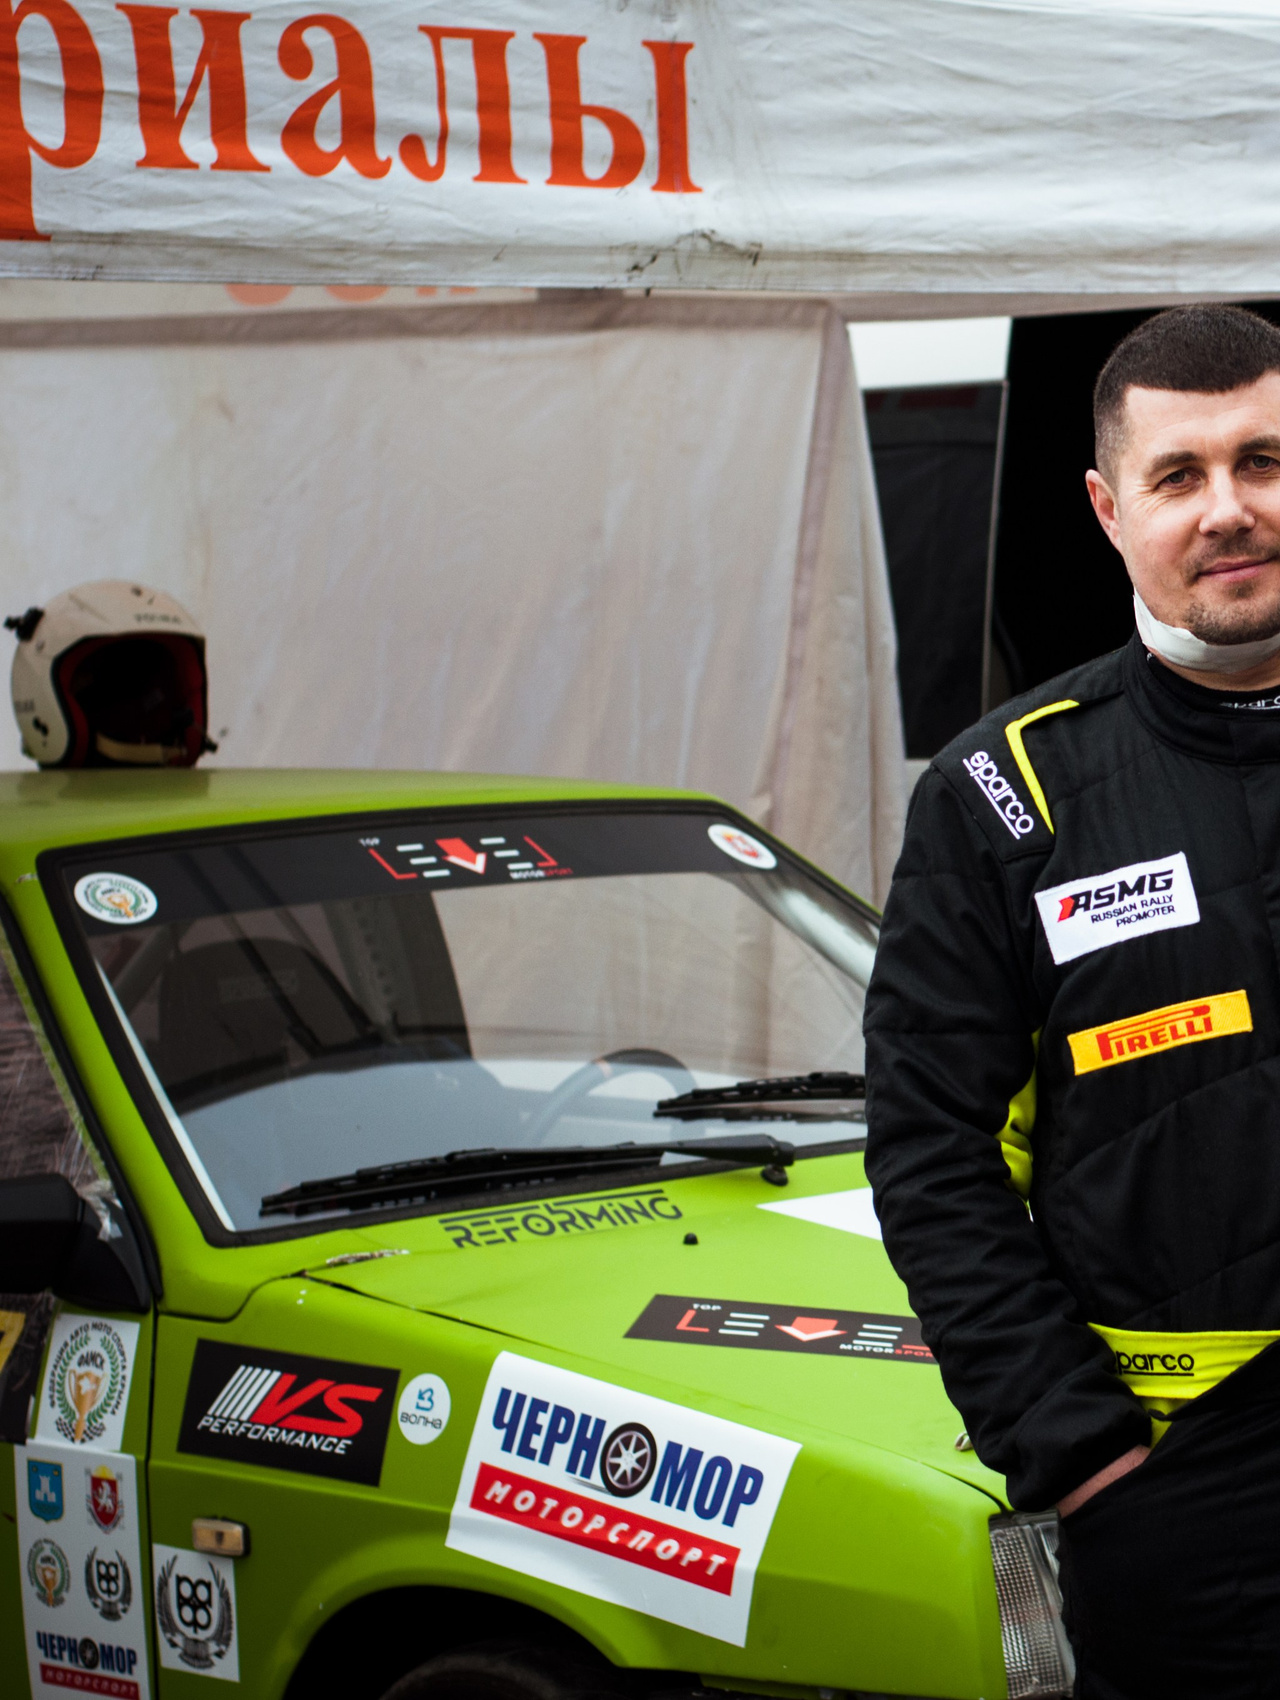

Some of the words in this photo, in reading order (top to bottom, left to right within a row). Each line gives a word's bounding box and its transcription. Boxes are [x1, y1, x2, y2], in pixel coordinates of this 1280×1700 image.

[0, 0, 703, 241] риалы
[962, 750, 1035, 839] sparco
[1057, 868, 1175, 923] ASMG
[1090, 903, 1137, 924] RUSSIAN
[1140, 894, 1174, 908] RALLY
[1116, 904, 1176, 928] PROMOTER
[1098, 1004, 1214, 1061] PIRELLI
[438, 1190, 685, 1249] REFORMING
[692, 1302, 723, 1311] TOP
[251, 1372, 384, 1438] VS
[197, 1415, 353, 1455] PERFORMANCE
[484, 1478, 728, 1578] МОТОРСПОРТ
[44, 1667, 137, 1696] МОТОРСПОРТ
